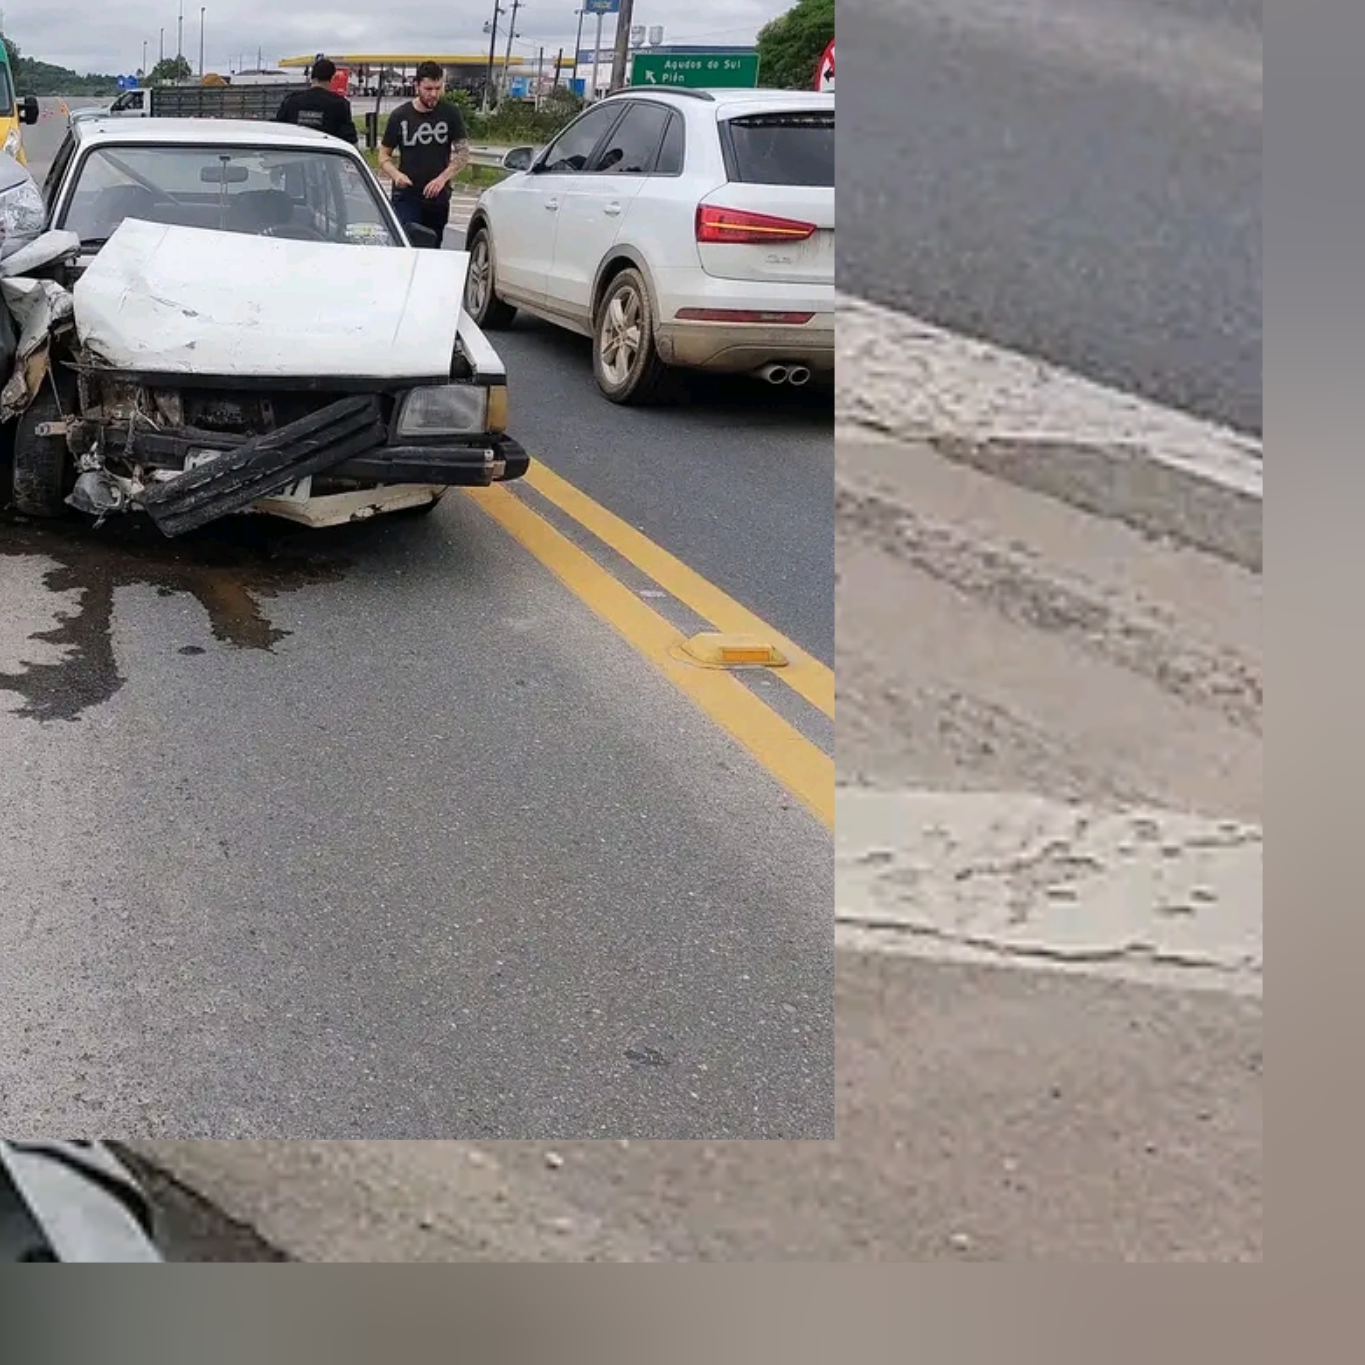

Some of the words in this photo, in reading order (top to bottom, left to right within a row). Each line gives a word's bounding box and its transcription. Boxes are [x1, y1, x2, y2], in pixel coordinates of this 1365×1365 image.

[664, 59, 702, 71] Agudos
[723, 59, 741, 70] Sul
[400, 120, 450, 147] Lee
